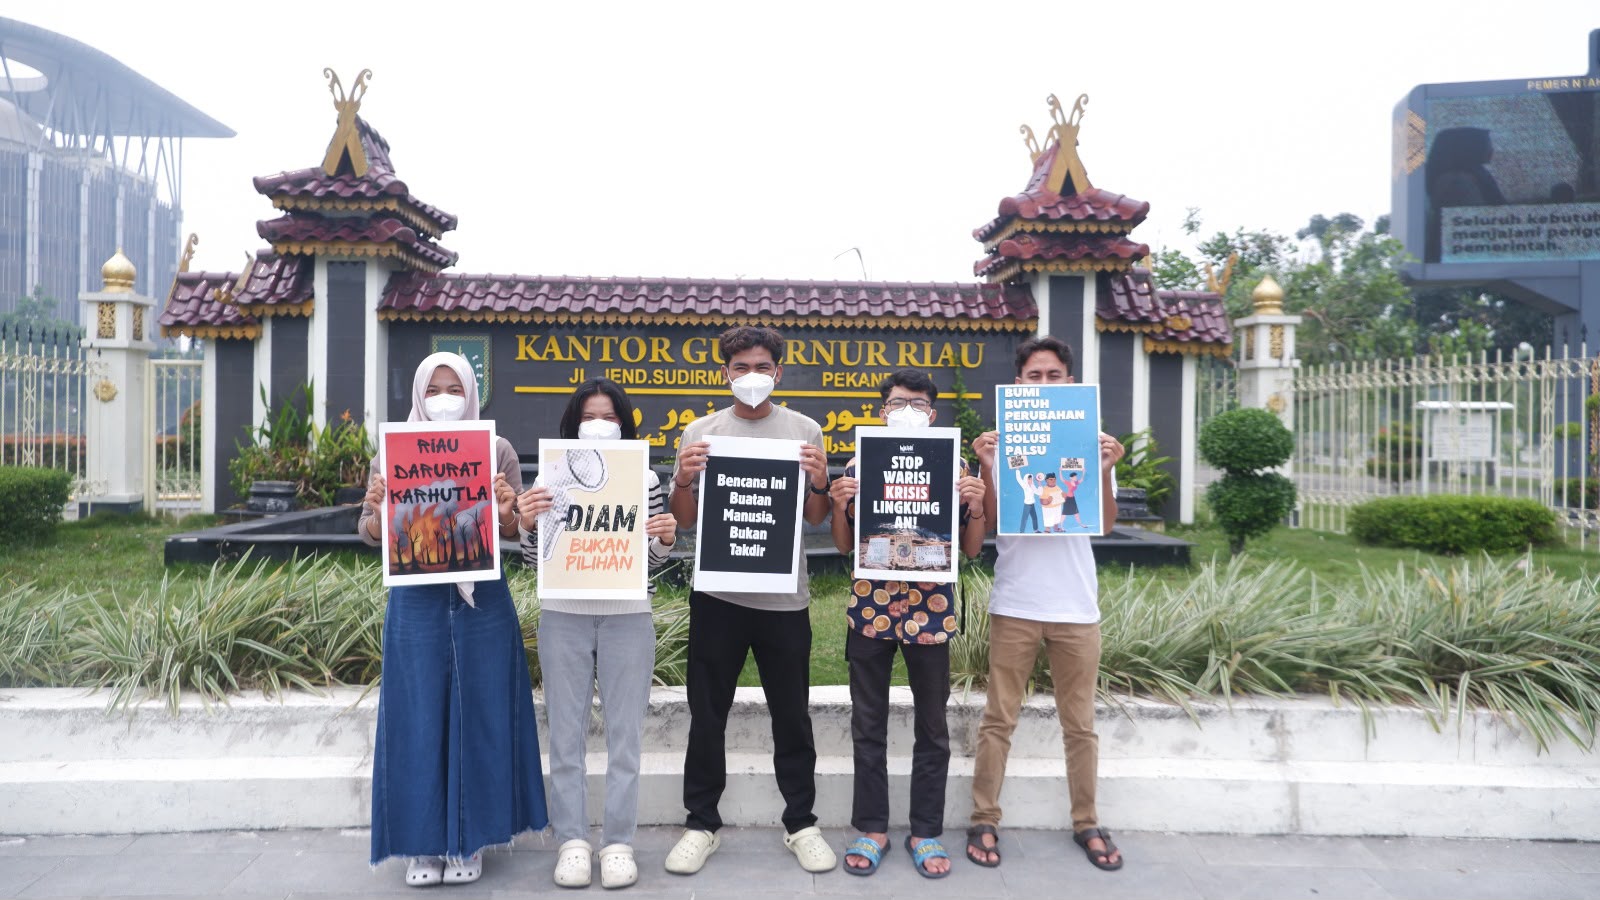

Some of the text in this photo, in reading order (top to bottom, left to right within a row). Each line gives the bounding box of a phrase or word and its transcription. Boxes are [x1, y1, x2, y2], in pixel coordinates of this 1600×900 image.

[1453, 214, 1521, 226] Seluruh
[1453, 227, 1541, 241] menjalani
[515, 334, 985, 368] KANTOR GURNUR RIAU
[1004, 387, 1040, 398] BUMI
[1004, 399, 1050, 409] BUTUH
[1004, 410, 1085, 421] PERUBAHAN
[1005, 422, 1051, 433] BUKAN
[1005, 433, 1051, 444] SOLUSI
[1005, 445, 1047, 456] PALSU
[394, 461, 482, 479] DARURAT
[891, 456, 923, 470] STOP
[717, 473, 787, 490] Bencana Ini
[883, 470, 931, 485] WARISI
[390, 485, 488, 504] KARHUTLA
[729, 491, 772, 507] Buatan
[885, 485, 928, 500] KRISIS
[873, 500, 940, 515] LINGKUNG
[565, 504, 638, 532] DIAM
[723, 508, 776, 525] Manusia,
[894, 516, 918, 530] AN!
[729, 526, 767, 541] Bukan
[569, 537, 630, 554] BUKAN
[729, 543, 766, 558] Takdir
[565, 553, 634, 572] PILIHAN
